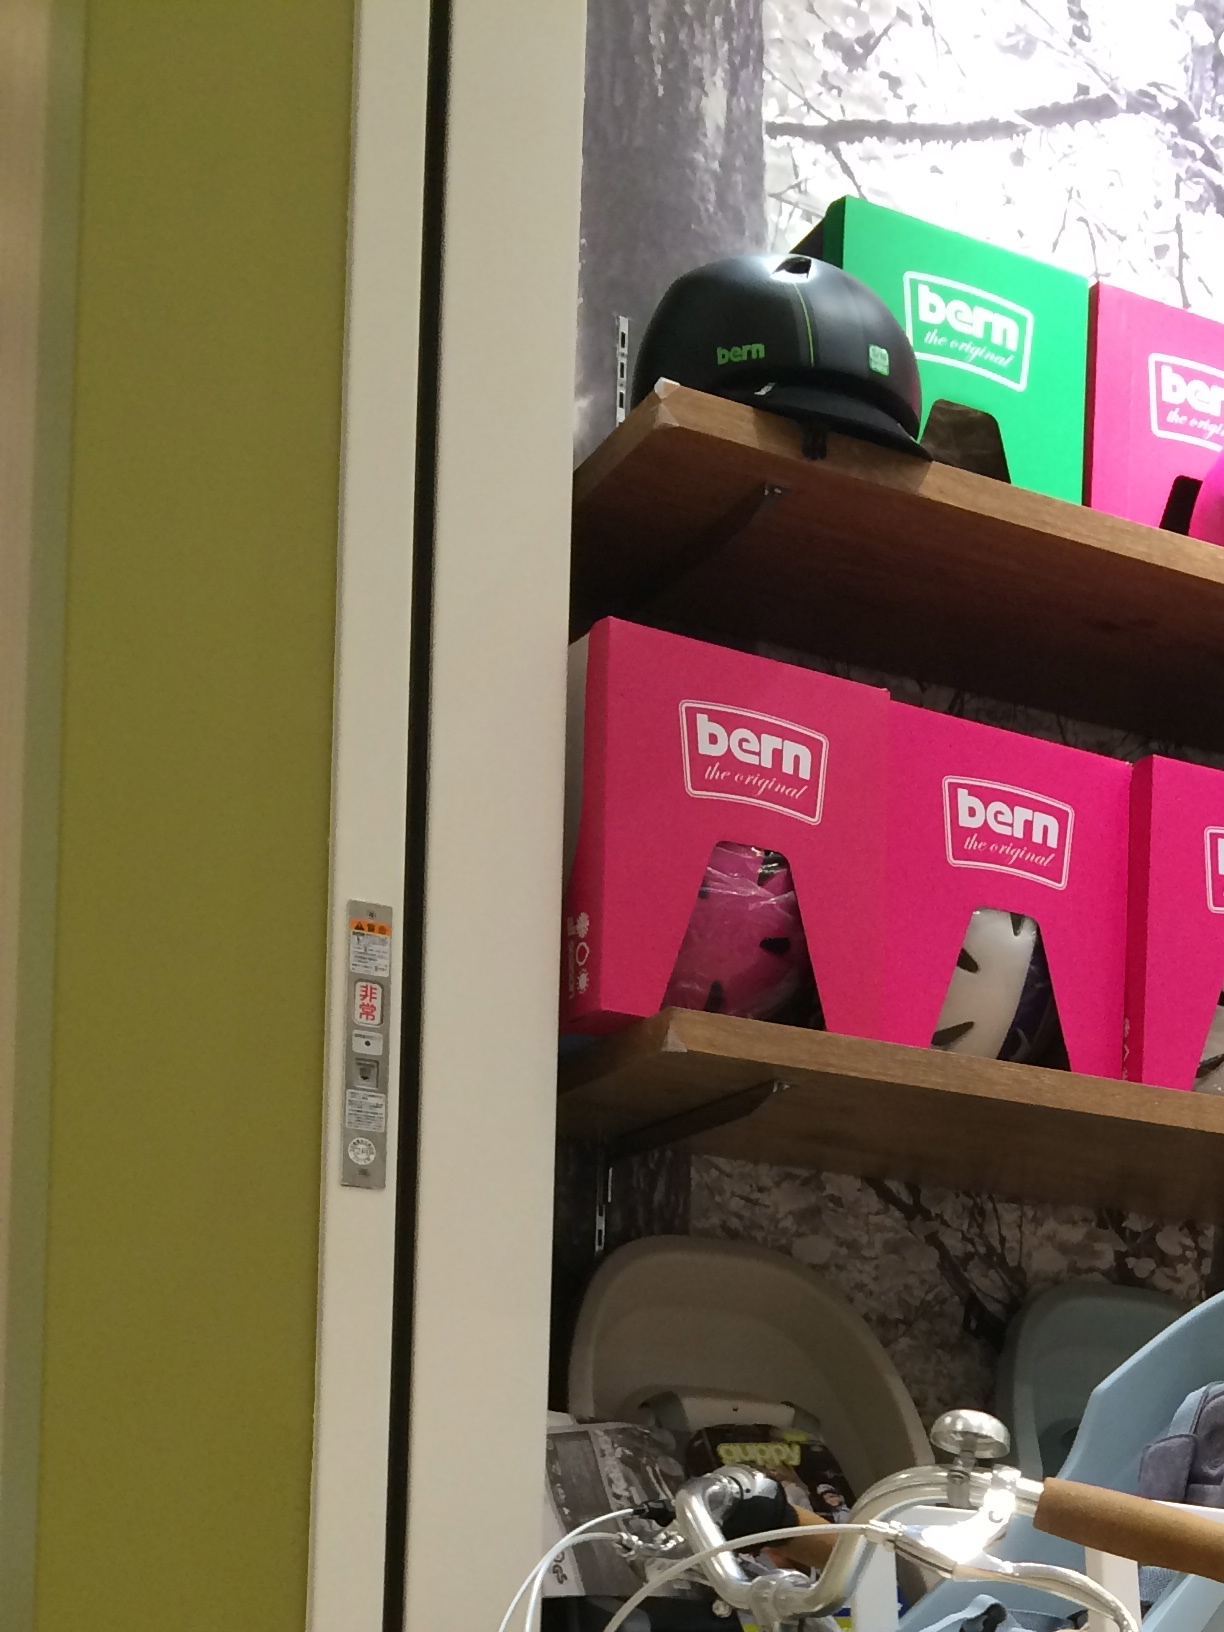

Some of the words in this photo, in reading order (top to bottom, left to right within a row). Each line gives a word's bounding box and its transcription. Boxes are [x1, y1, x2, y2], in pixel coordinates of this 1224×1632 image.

[917, 283, 1019, 351] bern
[717, 343, 766, 365] bern
[924, 328, 948, 345] the
[949, 341, 1015, 367] original
[696, 713, 811, 780] bern
[704, 762, 731, 780] the
[734, 773, 808, 799] original
[957, 788, 1059, 849] bern
[963, 833, 987, 851] the
[989, 842, 1055, 866] original
[359, 983, 377, 1021] 非常
